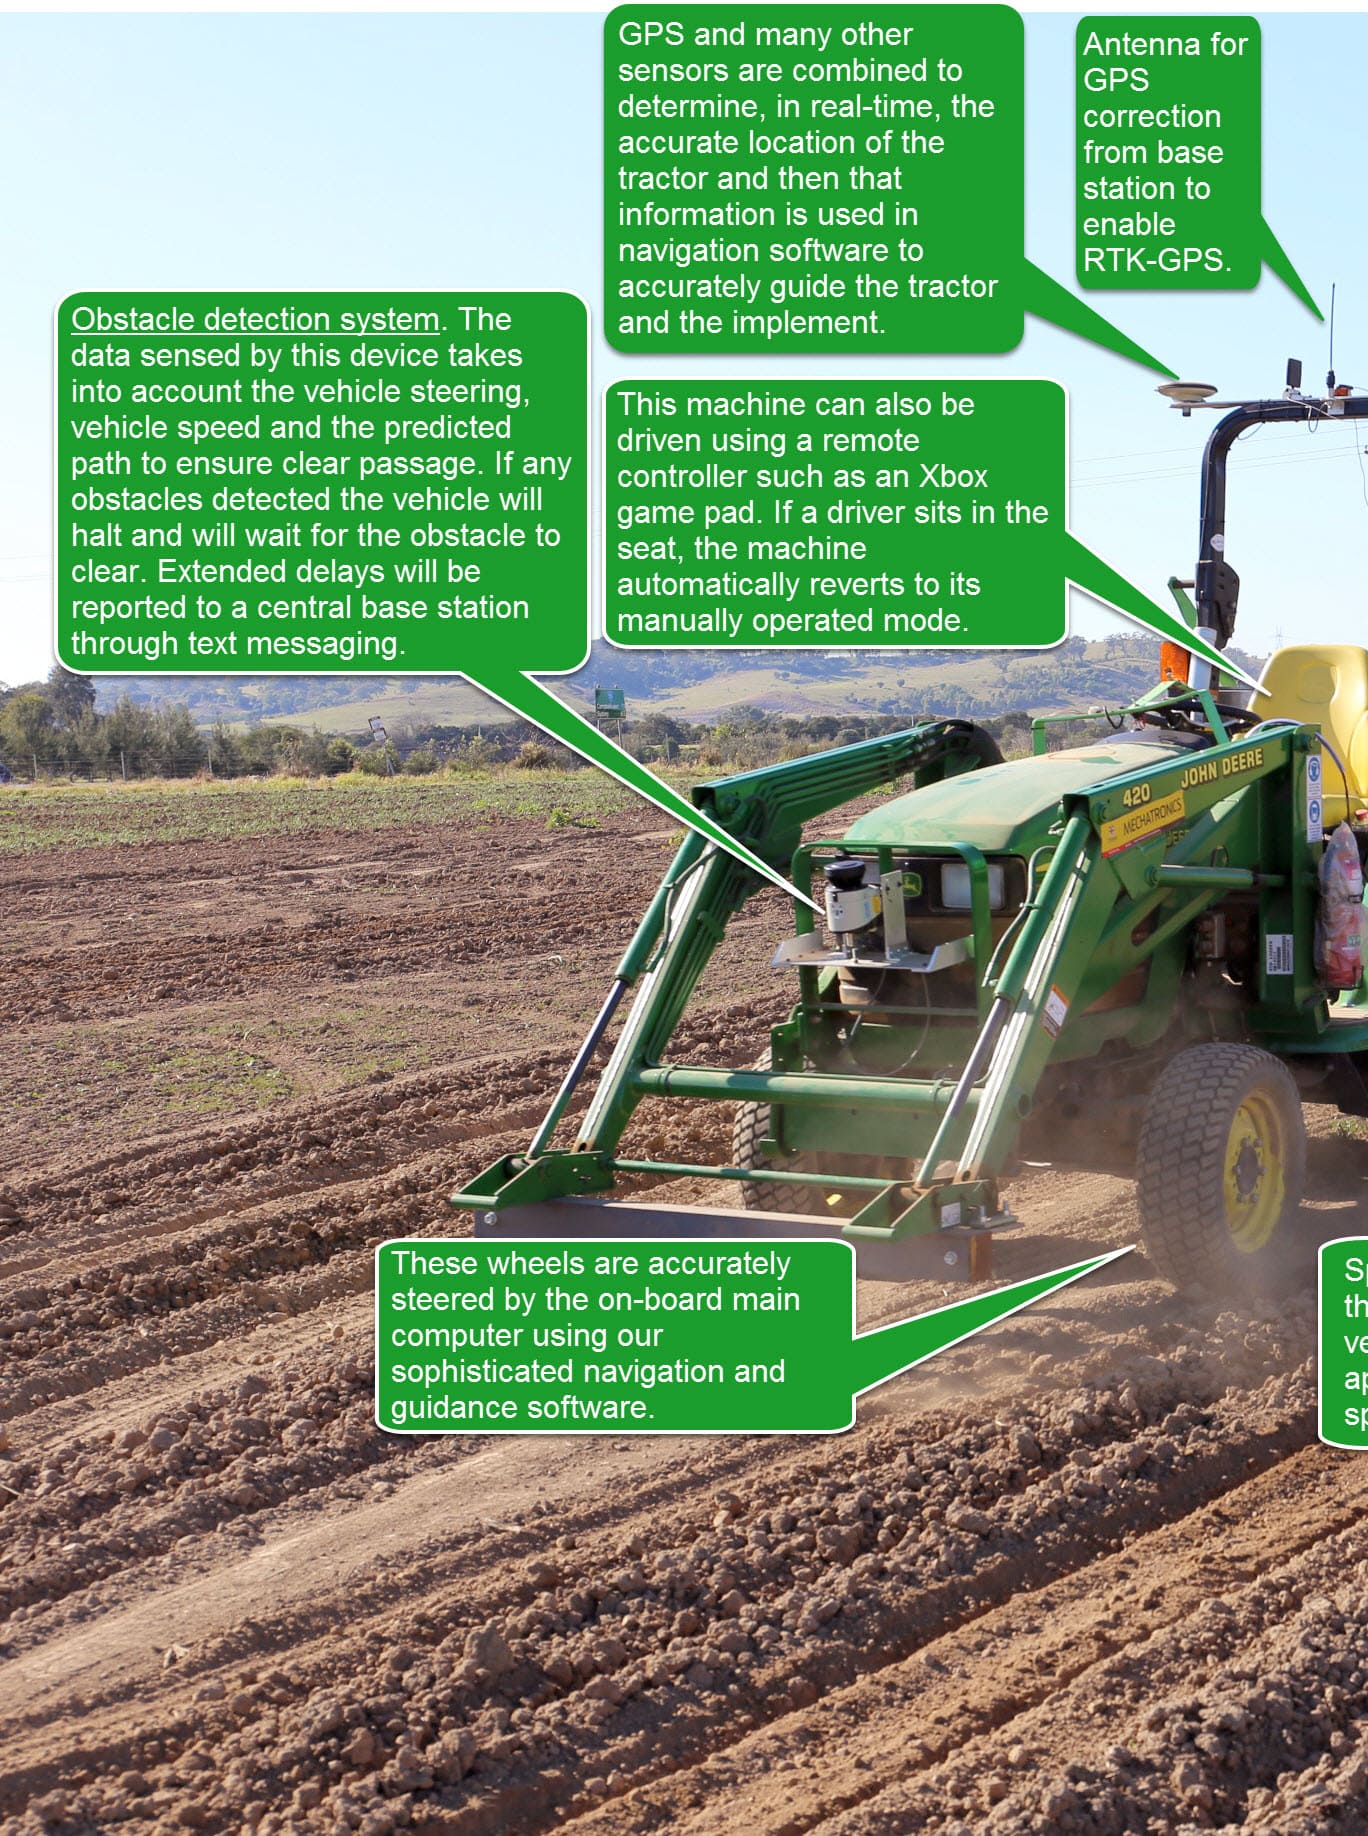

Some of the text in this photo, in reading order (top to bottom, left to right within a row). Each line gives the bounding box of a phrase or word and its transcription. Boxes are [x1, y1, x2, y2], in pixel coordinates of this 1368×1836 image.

[1181, 748, 1264, 789] JOHN DEERE
[1123, 783, 1151, 807] 420
[1123, 797, 1183, 835] MECHATRONICS
